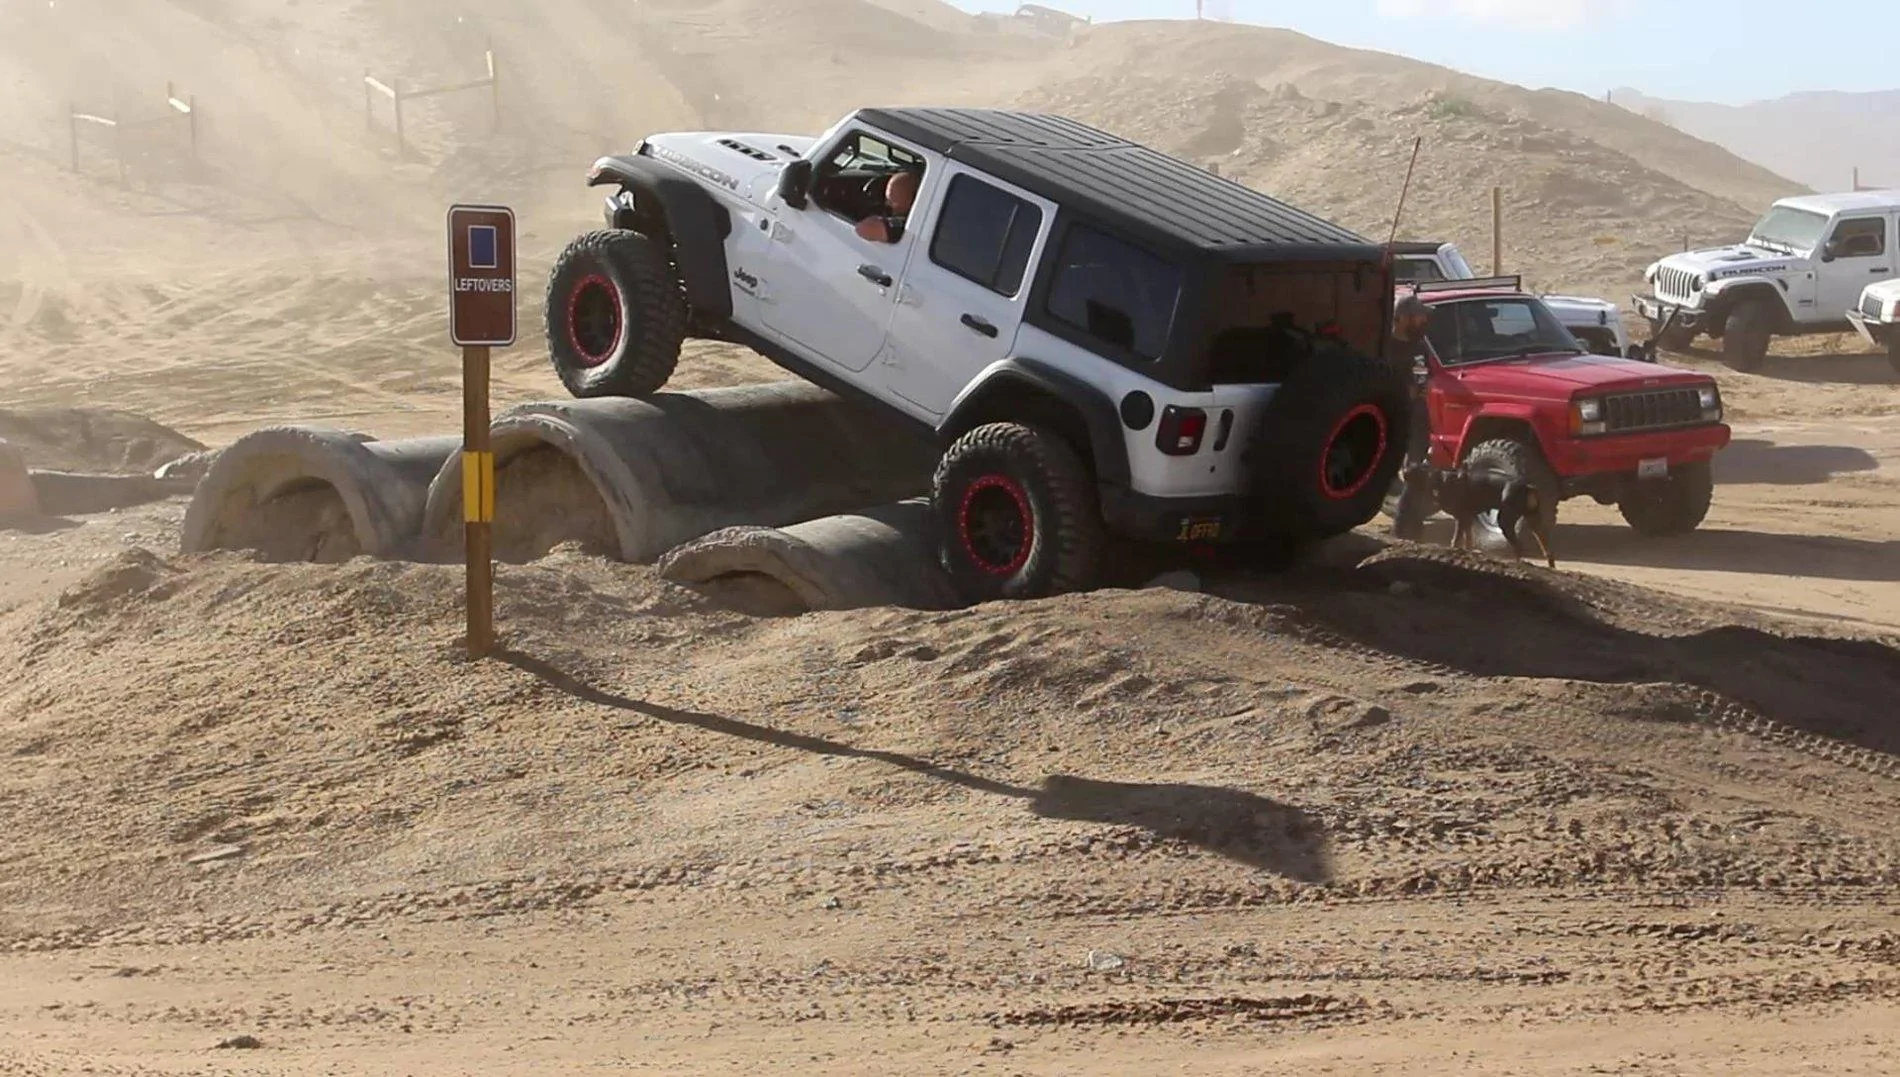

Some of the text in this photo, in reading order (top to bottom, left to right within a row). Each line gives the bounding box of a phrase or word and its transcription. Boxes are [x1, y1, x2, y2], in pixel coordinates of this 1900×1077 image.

[733, 266, 758, 289] Jeep
[1721, 265, 1786, 277] RUBICON
[455, 277, 512, 292] LEFTOVERS
